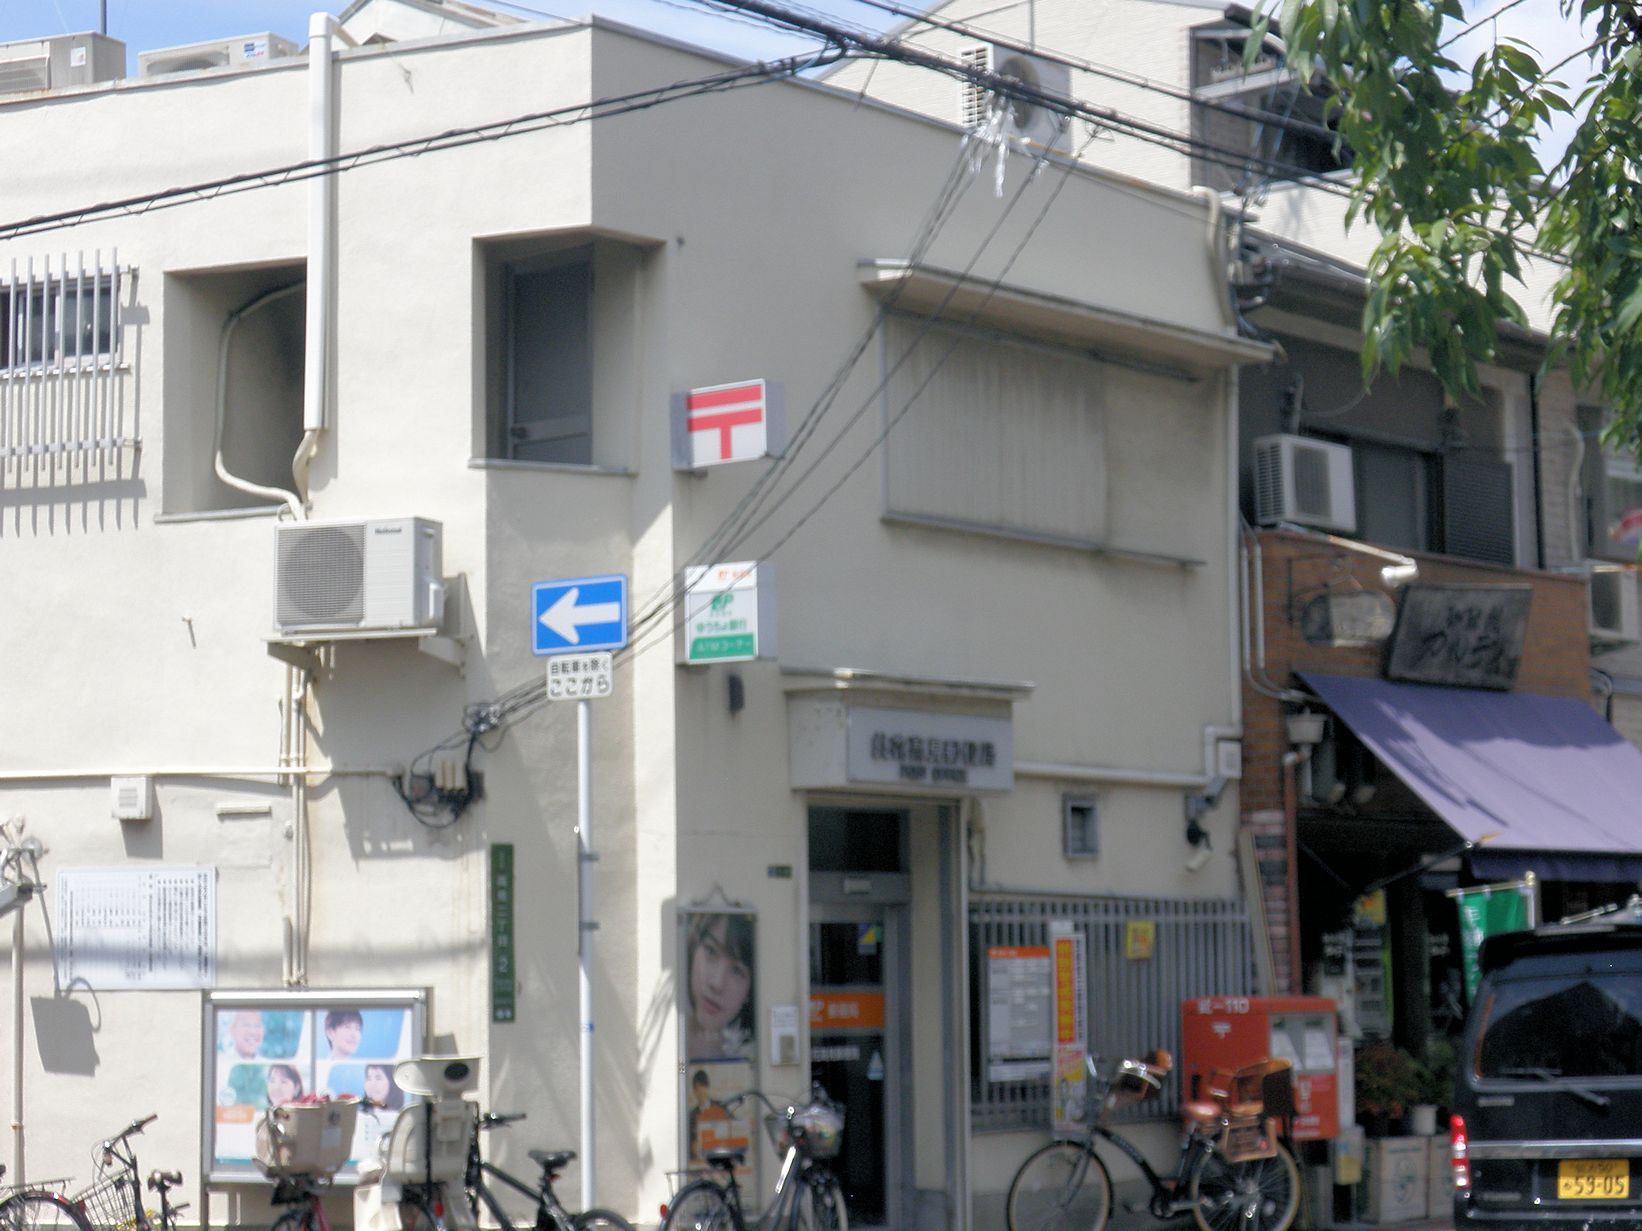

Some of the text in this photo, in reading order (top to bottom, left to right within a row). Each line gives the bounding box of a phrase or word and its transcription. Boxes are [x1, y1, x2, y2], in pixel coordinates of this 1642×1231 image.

[551, 658, 609, 675] 自転車を除く
[550, 673, 609, 696] ここから
